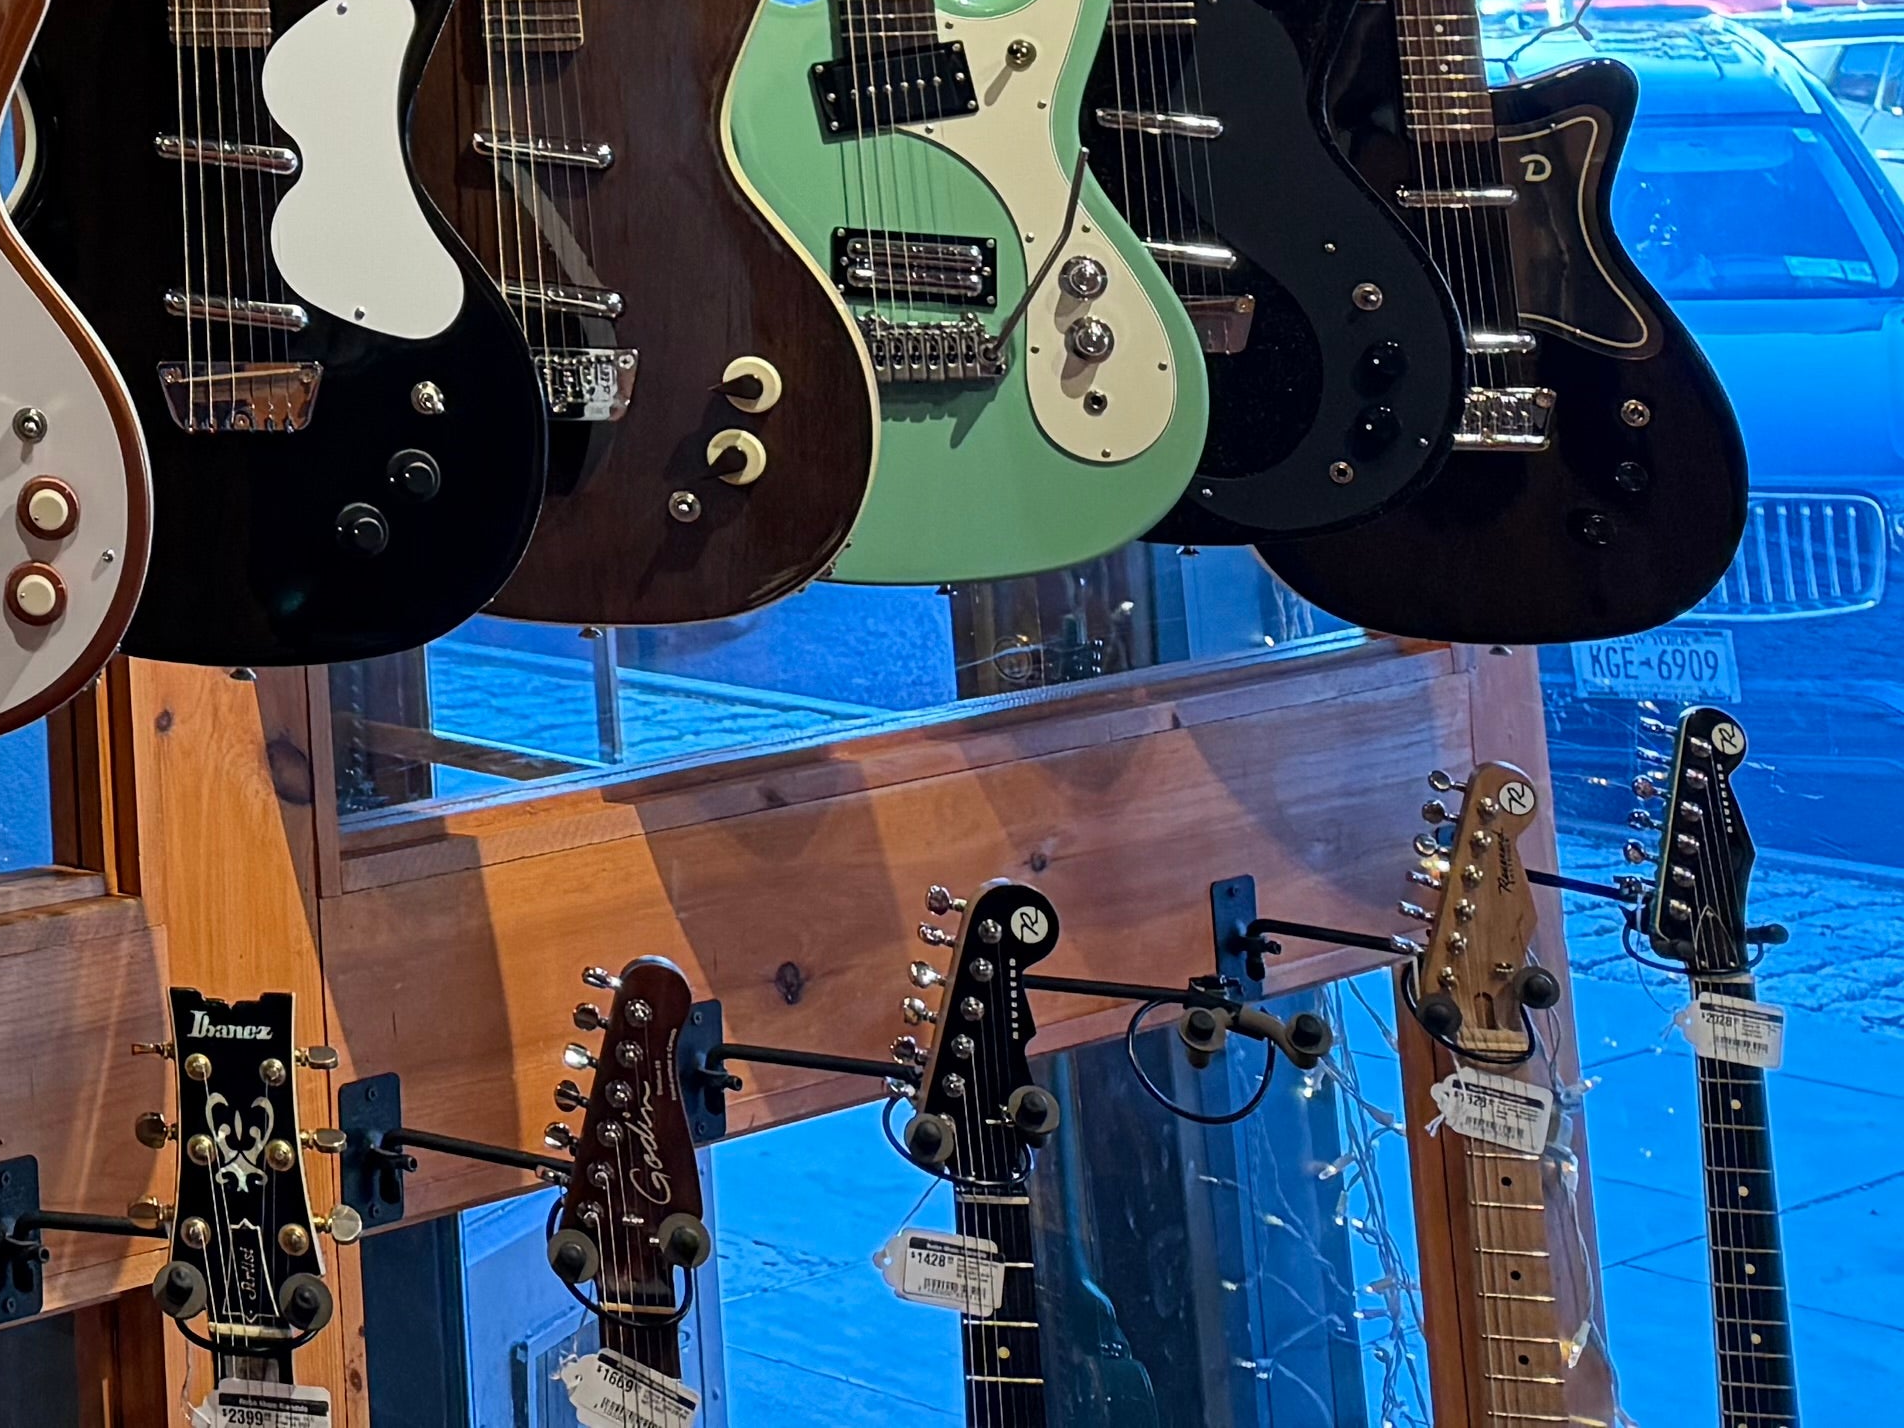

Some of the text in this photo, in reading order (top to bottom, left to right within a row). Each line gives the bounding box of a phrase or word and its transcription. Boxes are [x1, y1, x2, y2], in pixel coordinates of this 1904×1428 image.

[1519, 154, 1552, 182] D
[187, 1010, 274, 1040] Ibanez
[629, 1080, 672, 1206] Godin
[911, 1251, 947, 1268] $1428
[222, 1408, 264, 1426] $2399
